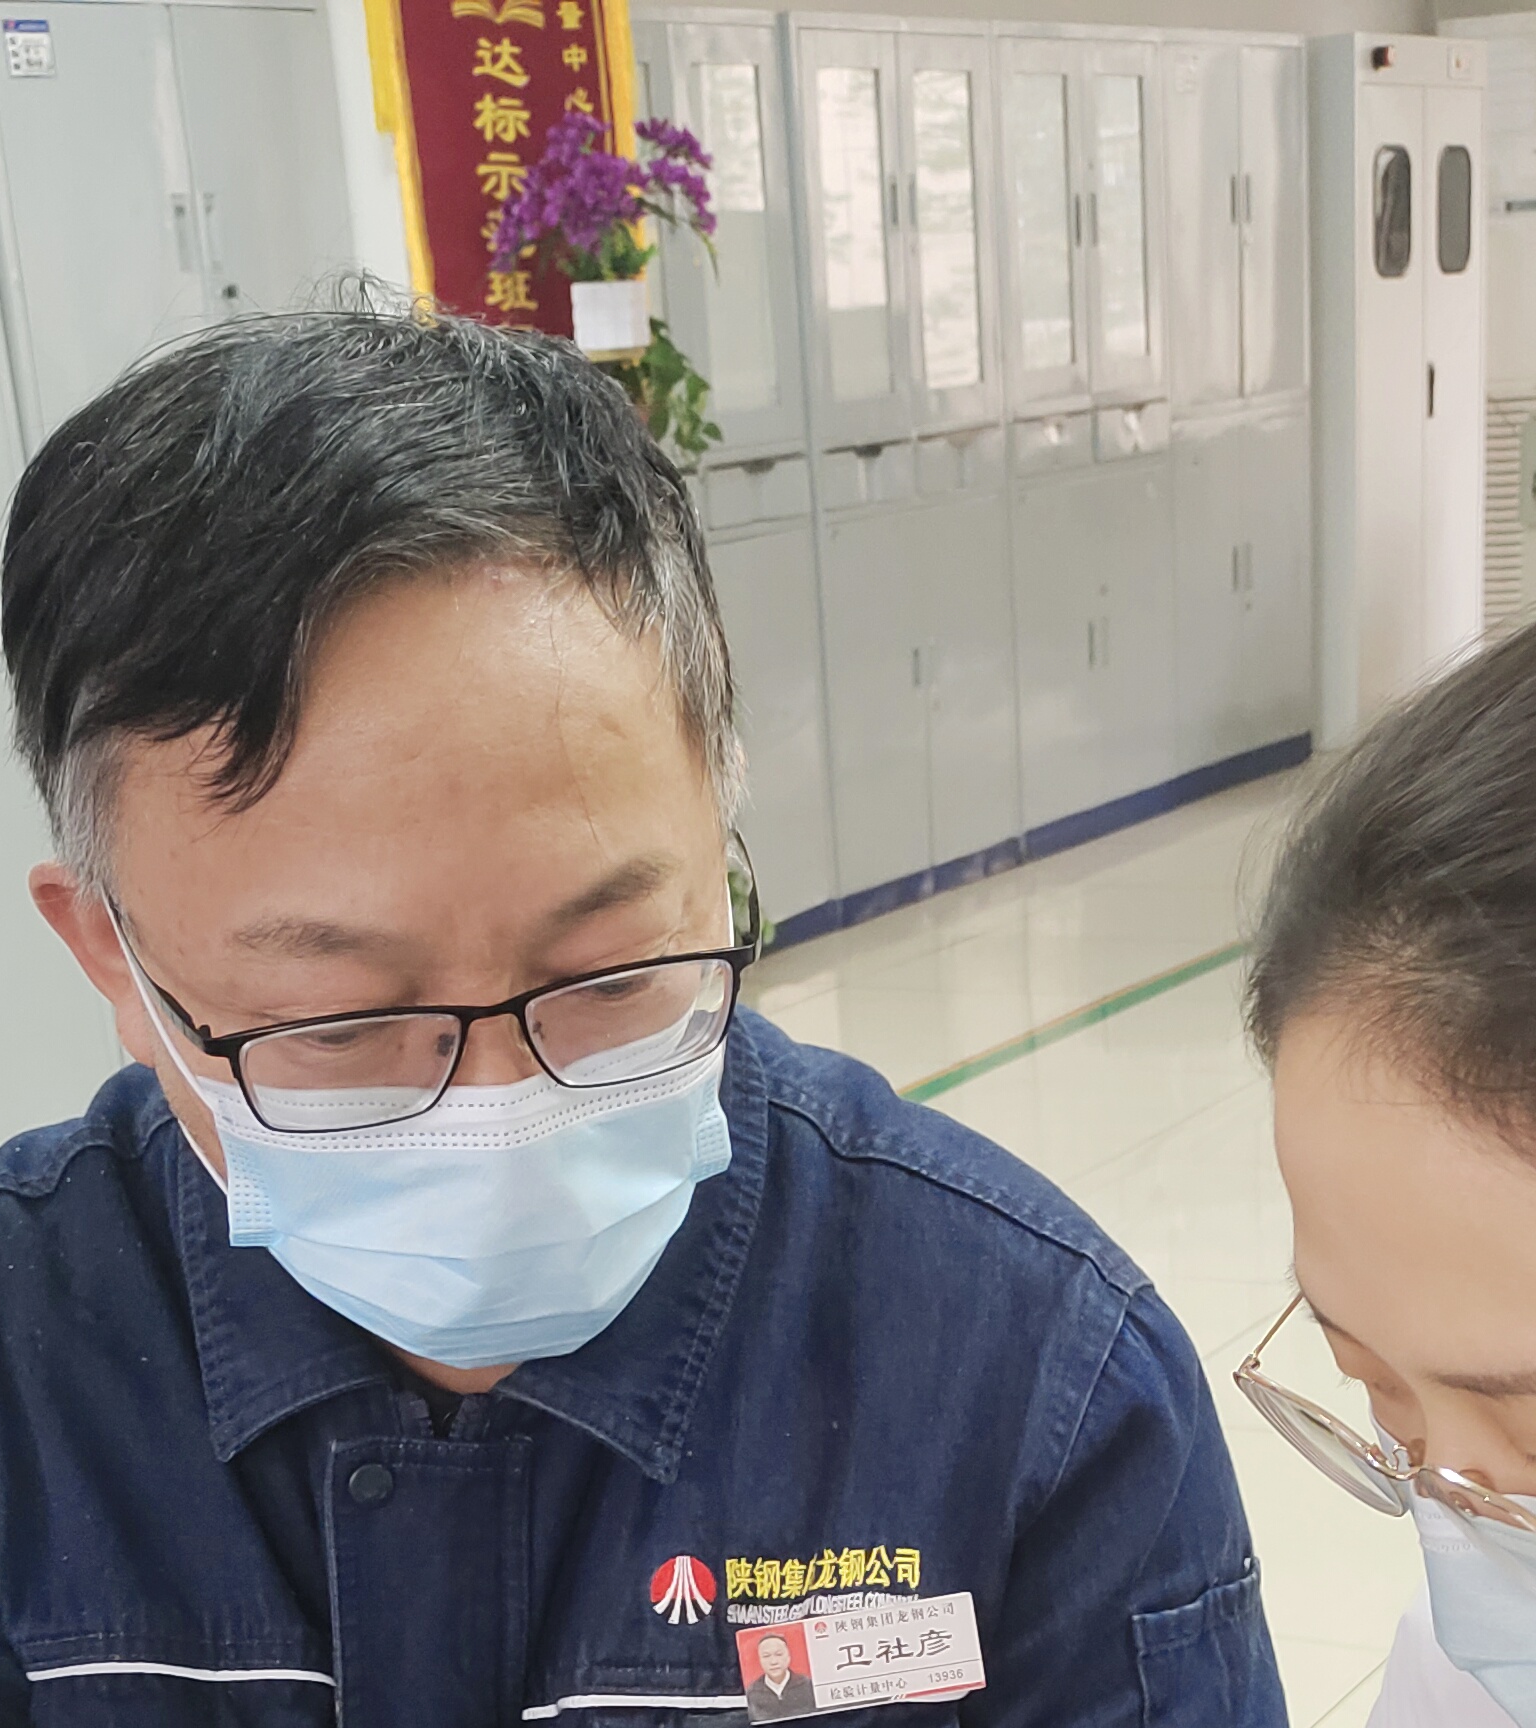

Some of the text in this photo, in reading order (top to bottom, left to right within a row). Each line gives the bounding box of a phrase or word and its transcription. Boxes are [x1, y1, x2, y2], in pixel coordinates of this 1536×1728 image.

[472, 37, 538, 331] 达标示班
[726, 1545, 920, 1599] 陕钢集龙钢公司
[835, 1603, 954, 1632] 陕钢集团龙钢公司
[837, 1630, 952, 1670] 卫社彦
[830, 1679, 908, 1700] 检验计量中心
[928, 1669, 964, 1684] 13936
